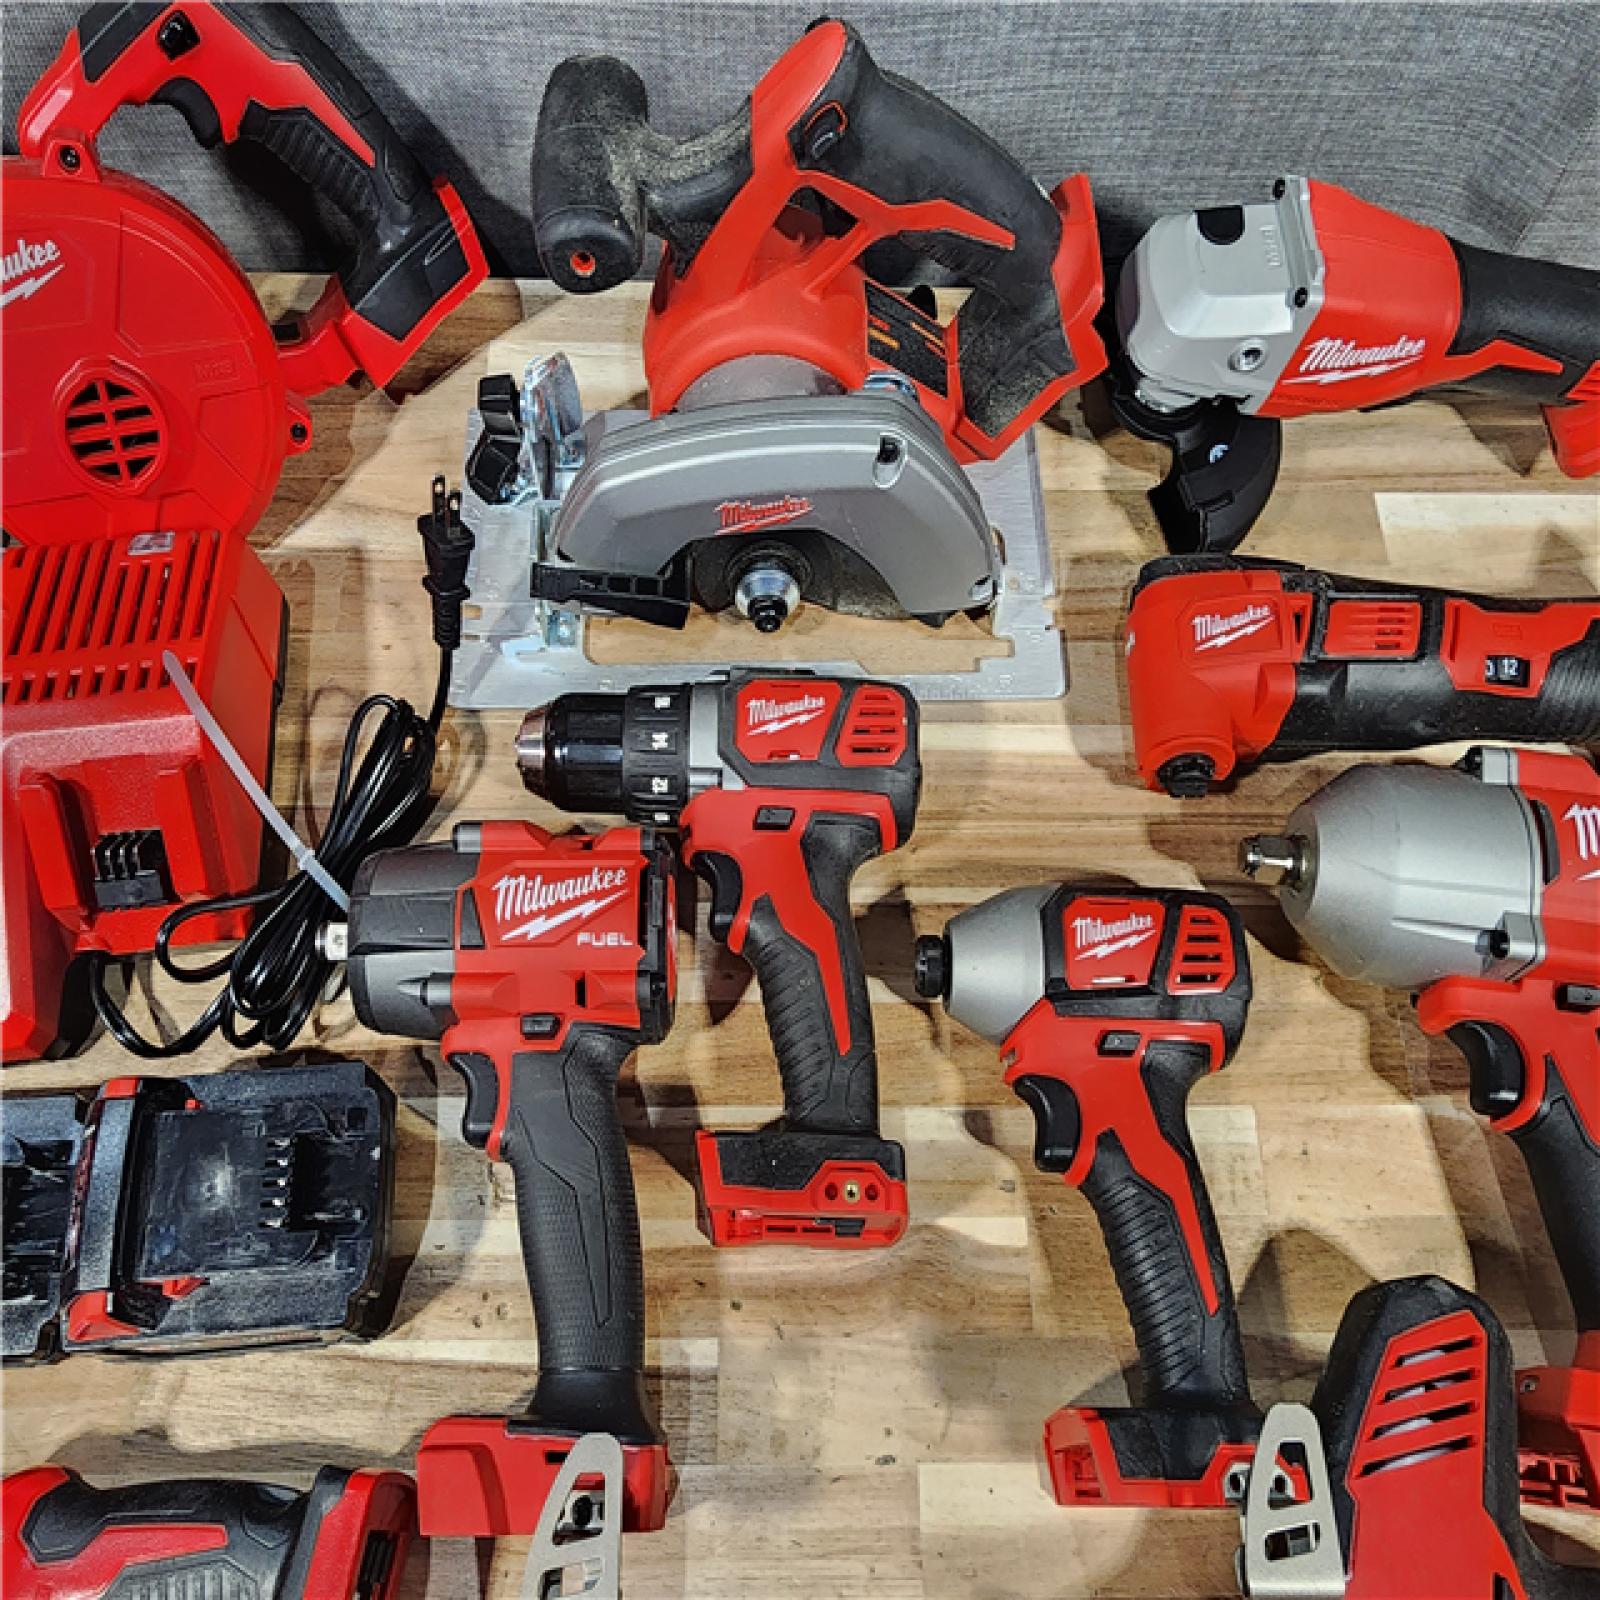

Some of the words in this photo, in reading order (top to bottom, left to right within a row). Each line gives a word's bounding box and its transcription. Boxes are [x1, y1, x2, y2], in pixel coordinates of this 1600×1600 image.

[1300, 335, 1425, 373] Milwaukee
[713, 495, 815, 528] Milwaukee
[1192, 605, 1270, 642] Milwaukee
[745, 695, 825, 726] Milwaukee
[491, 867, 628, 924] Milwaukee
[577, 931, 633, 946] FUEL
[1070, 913, 1153, 949] Milwaukee
